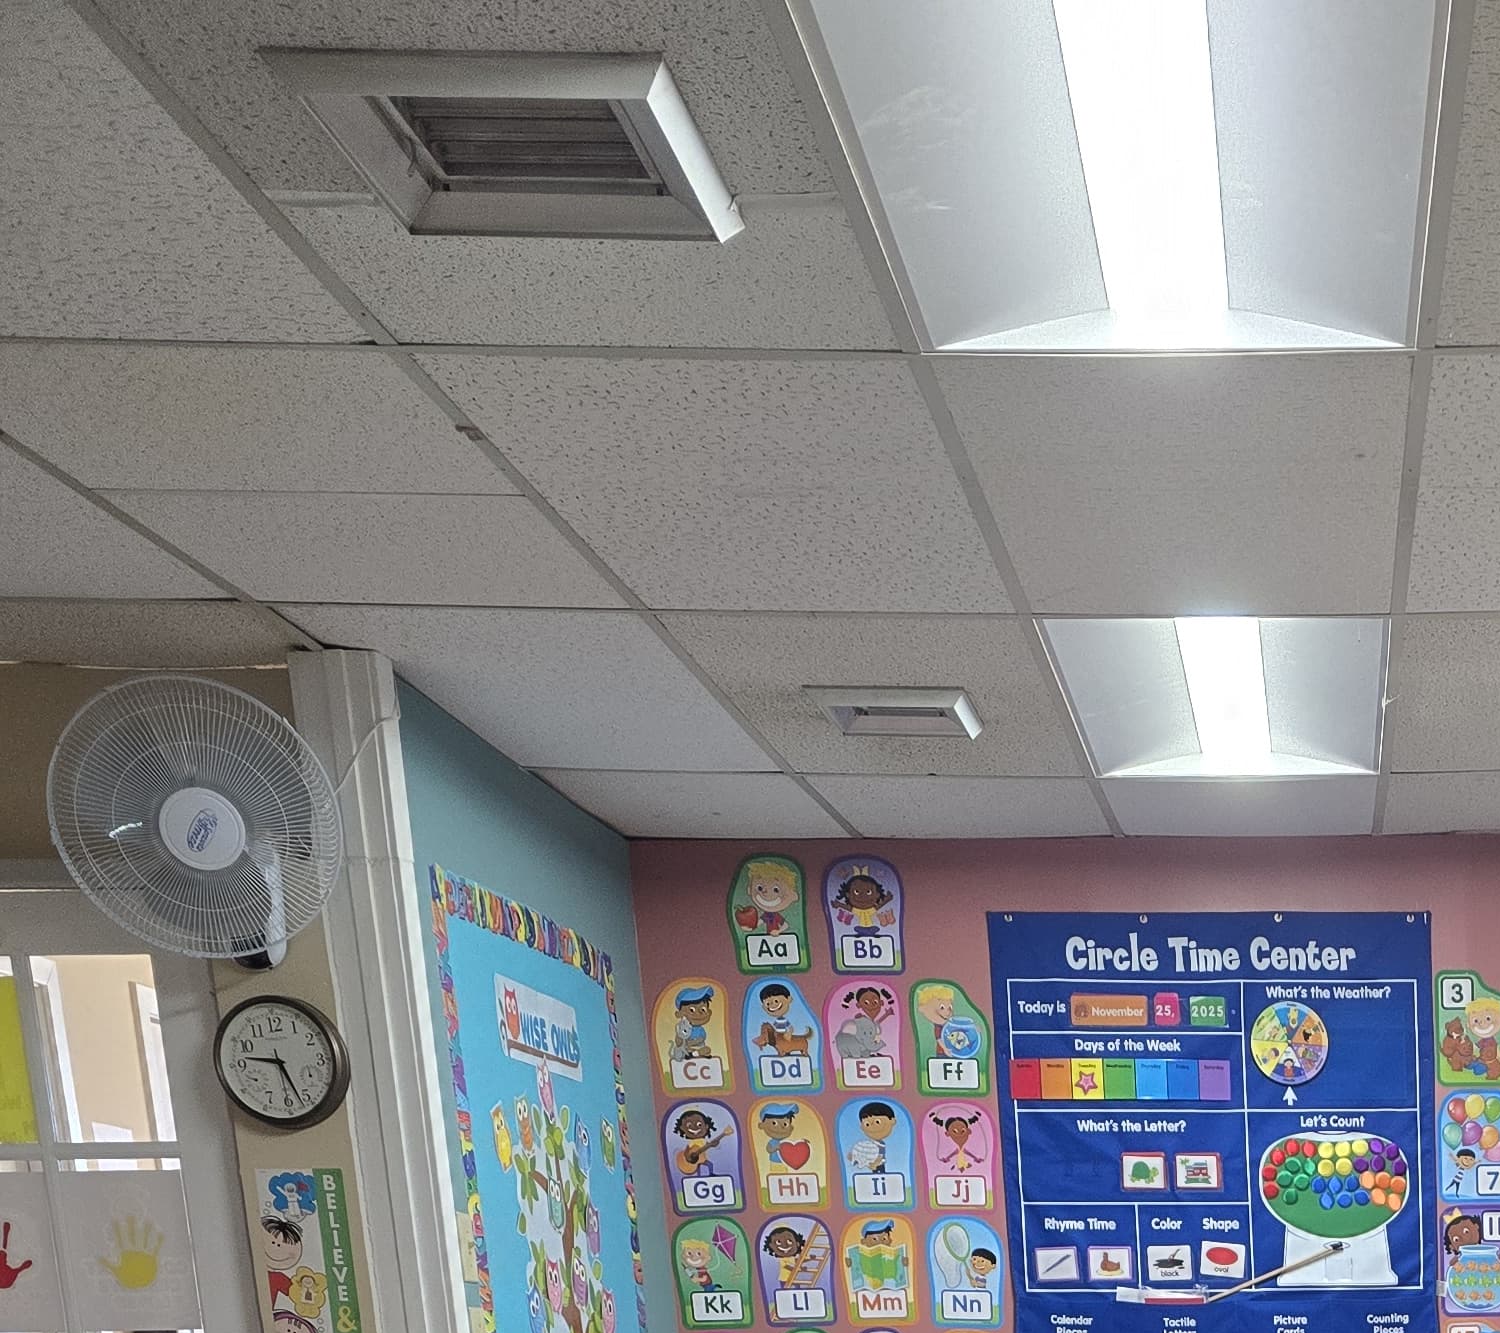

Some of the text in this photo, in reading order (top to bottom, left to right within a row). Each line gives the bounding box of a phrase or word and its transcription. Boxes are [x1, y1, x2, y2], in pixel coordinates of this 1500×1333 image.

[758, 940, 788, 958] Aa
[854, 940, 882, 958] Bb
[1066, 933, 1356, 973] Circle Time Center
[1266, 986, 1390, 999] What's the Weather?
[1451, 983, 1464, 1002] 3
[1018, 1001, 1054, 1016] Today
[1057, 1001, 1066, 1014] is
[1091, 1005, 1143, 1017] November
[1191, 1005, 1224, 1018] 2025
[251, 1024, 264, 1037] 11
[268, 1017, 283, 1032] 12
[305, 1033, 315, 1046] 2
[520, 1012, 580, 1061] WISE OWLS
[240, 1040, 253, 1053] 10
[1075, 1039, 1180, 1053] Days of the Week
[238, 1059, 246, 1072] 9
[316, 1053, 325, 1066] 3
[683, 1062, 712, 1080] Cc
[771, 1060, 801, 1078] Dd
[856, 1060, 881, 1078] Ee
[943, 1062, 964, 1080] Ff
[1077, 1119, 1186, 1133] What's the Letter?
[1301, 1116, 1364, 1128] Let's Count
[778, 1178, 808, 1197] Hh
[1487, 1172, 1499, 1190] 7
[694, 1181, 725, 1202] Gg
[952, 1179, 969, 1201] Jj
[1045, 1218, 1116, 1232] Rhyme Time
[1151, 1218, 1182, 1231] Color
[1202, 1218, 1239, 1232] Shape
[322, 1174, 350, 1301] BELIEVE
[337, 1307, 357, 1333] &
[1161, 1269, 1179, 1277] black
[704, 1296, 733, 1314] Kk
[862, 1295, 902, 1312] Mm
[952, 1295, 981, 1313] Nn
[1051, 1315, 1093, 1326] Calendar
[1163, 1317, 1196, 1328] Tactile
[1274, 1315, 1307, 1326] Picture
[1367, 1312, 1409, 1326] Counting
